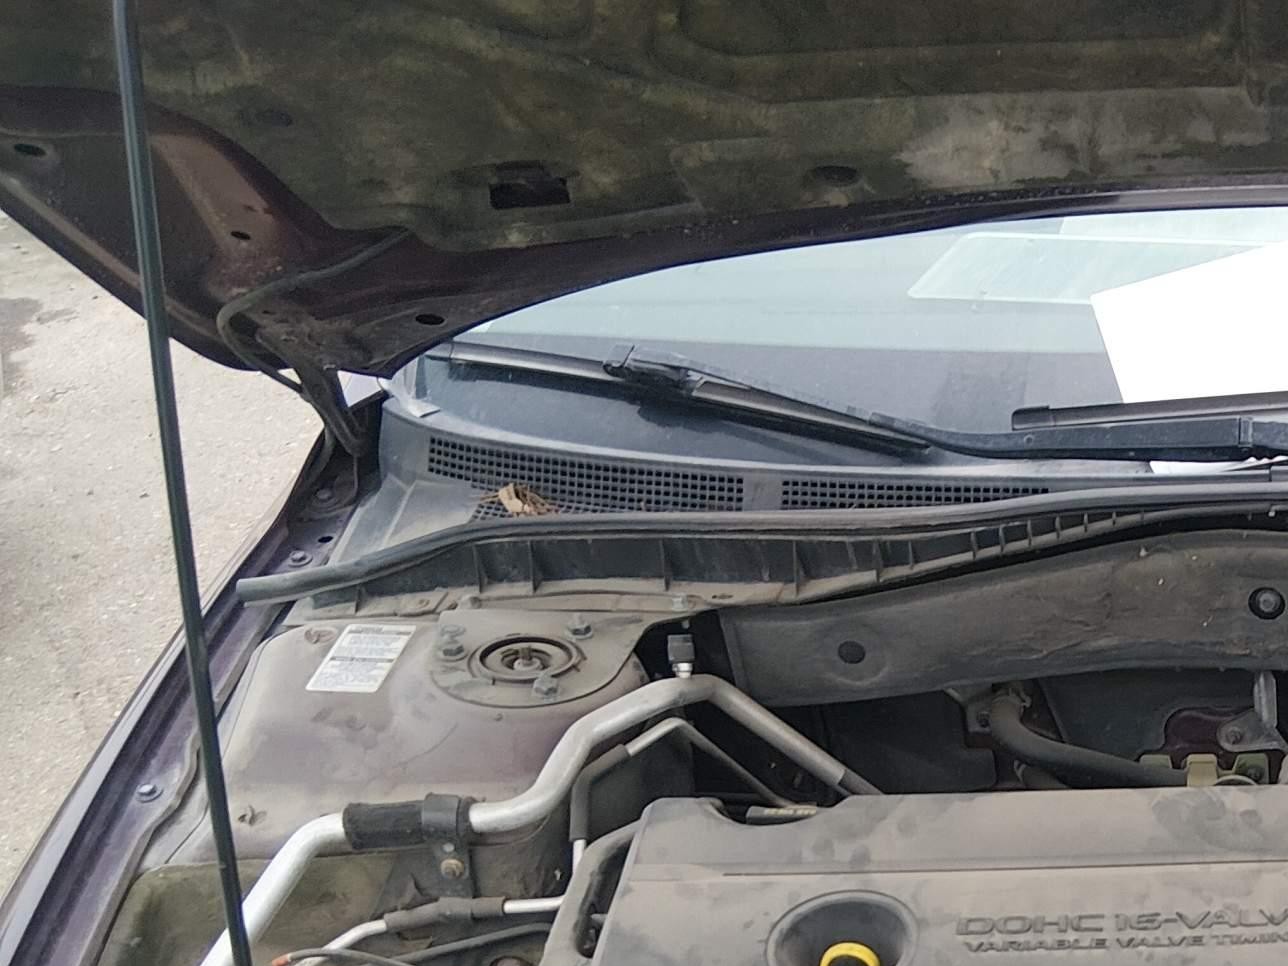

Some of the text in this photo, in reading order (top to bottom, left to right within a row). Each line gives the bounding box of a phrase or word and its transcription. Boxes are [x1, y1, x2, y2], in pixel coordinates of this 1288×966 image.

[955, 914, 1105, 936] DOHC
[963, 937, 1108, 953] VARIABLE
[1116, 934, 1205, 949] VALVE
